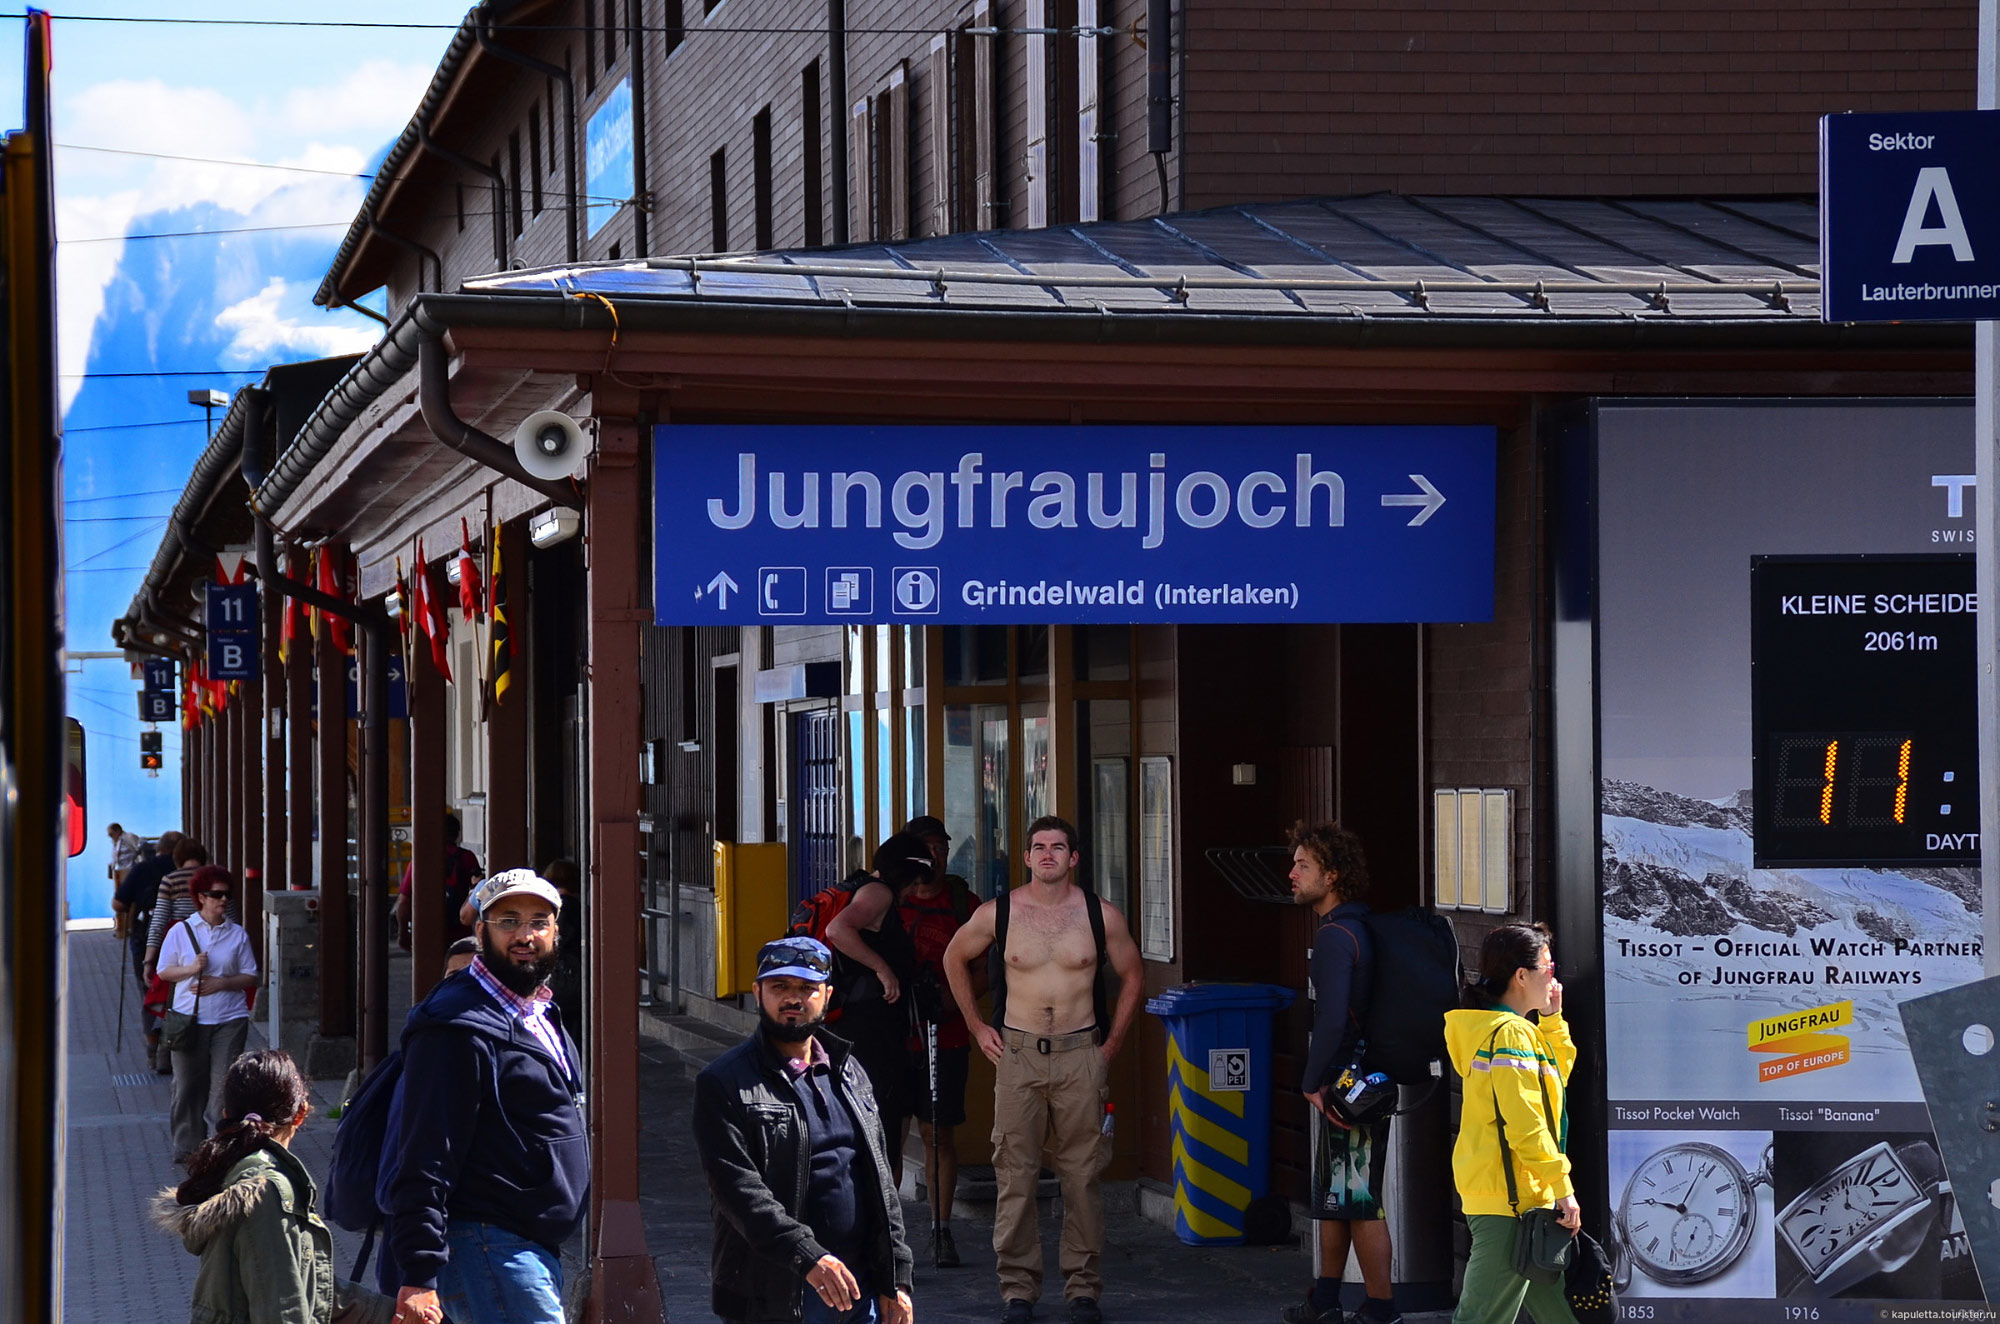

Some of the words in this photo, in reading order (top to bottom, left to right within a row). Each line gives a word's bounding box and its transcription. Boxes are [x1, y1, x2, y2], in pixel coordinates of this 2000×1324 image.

[1868, 132, 1935, 151] Sektor
[1891, 166, 1976, 264] A
[706, 452, 1346, 550] Jungfraujoch
[961, 579, 1145, 606] Grindelwald
[1154, 582, 1299, 609] (Interlaken)
[1781, 594, 1867, 615] KLEINE
[1873, 593, 1978, 614] SCHEIDE
[220, 598, 242, 622] 11
[1863, 630, 1938, 651] 2061m
[223, 644, 242, 669] B
[152, 669, 167, 685] 11
[153, 698, 166, 715] B
[1759, 1008, 1841, 1042] JUNGFRAU
[1762, 1064, 1784, 1077] TOP
[1786, 1060, 1801, 1072] OF
[1803, 1050, 1845, 1068] EUROPE
[1228, 1075, 1245, 1085] PET
[1615, 1106, 1651, 1121] Tissot
[1653, 1106, 1695, 1121] Pocket
[1698, 1106, 1741, 1121] Watch
[1778, 1107, 1814, 1121] Tissot
[1818, 1108, 1880, 1122] "Banana"
[1620, 1305, 1656, 1320] 1853
[1784, 1306, 1820, 1320] 1916
